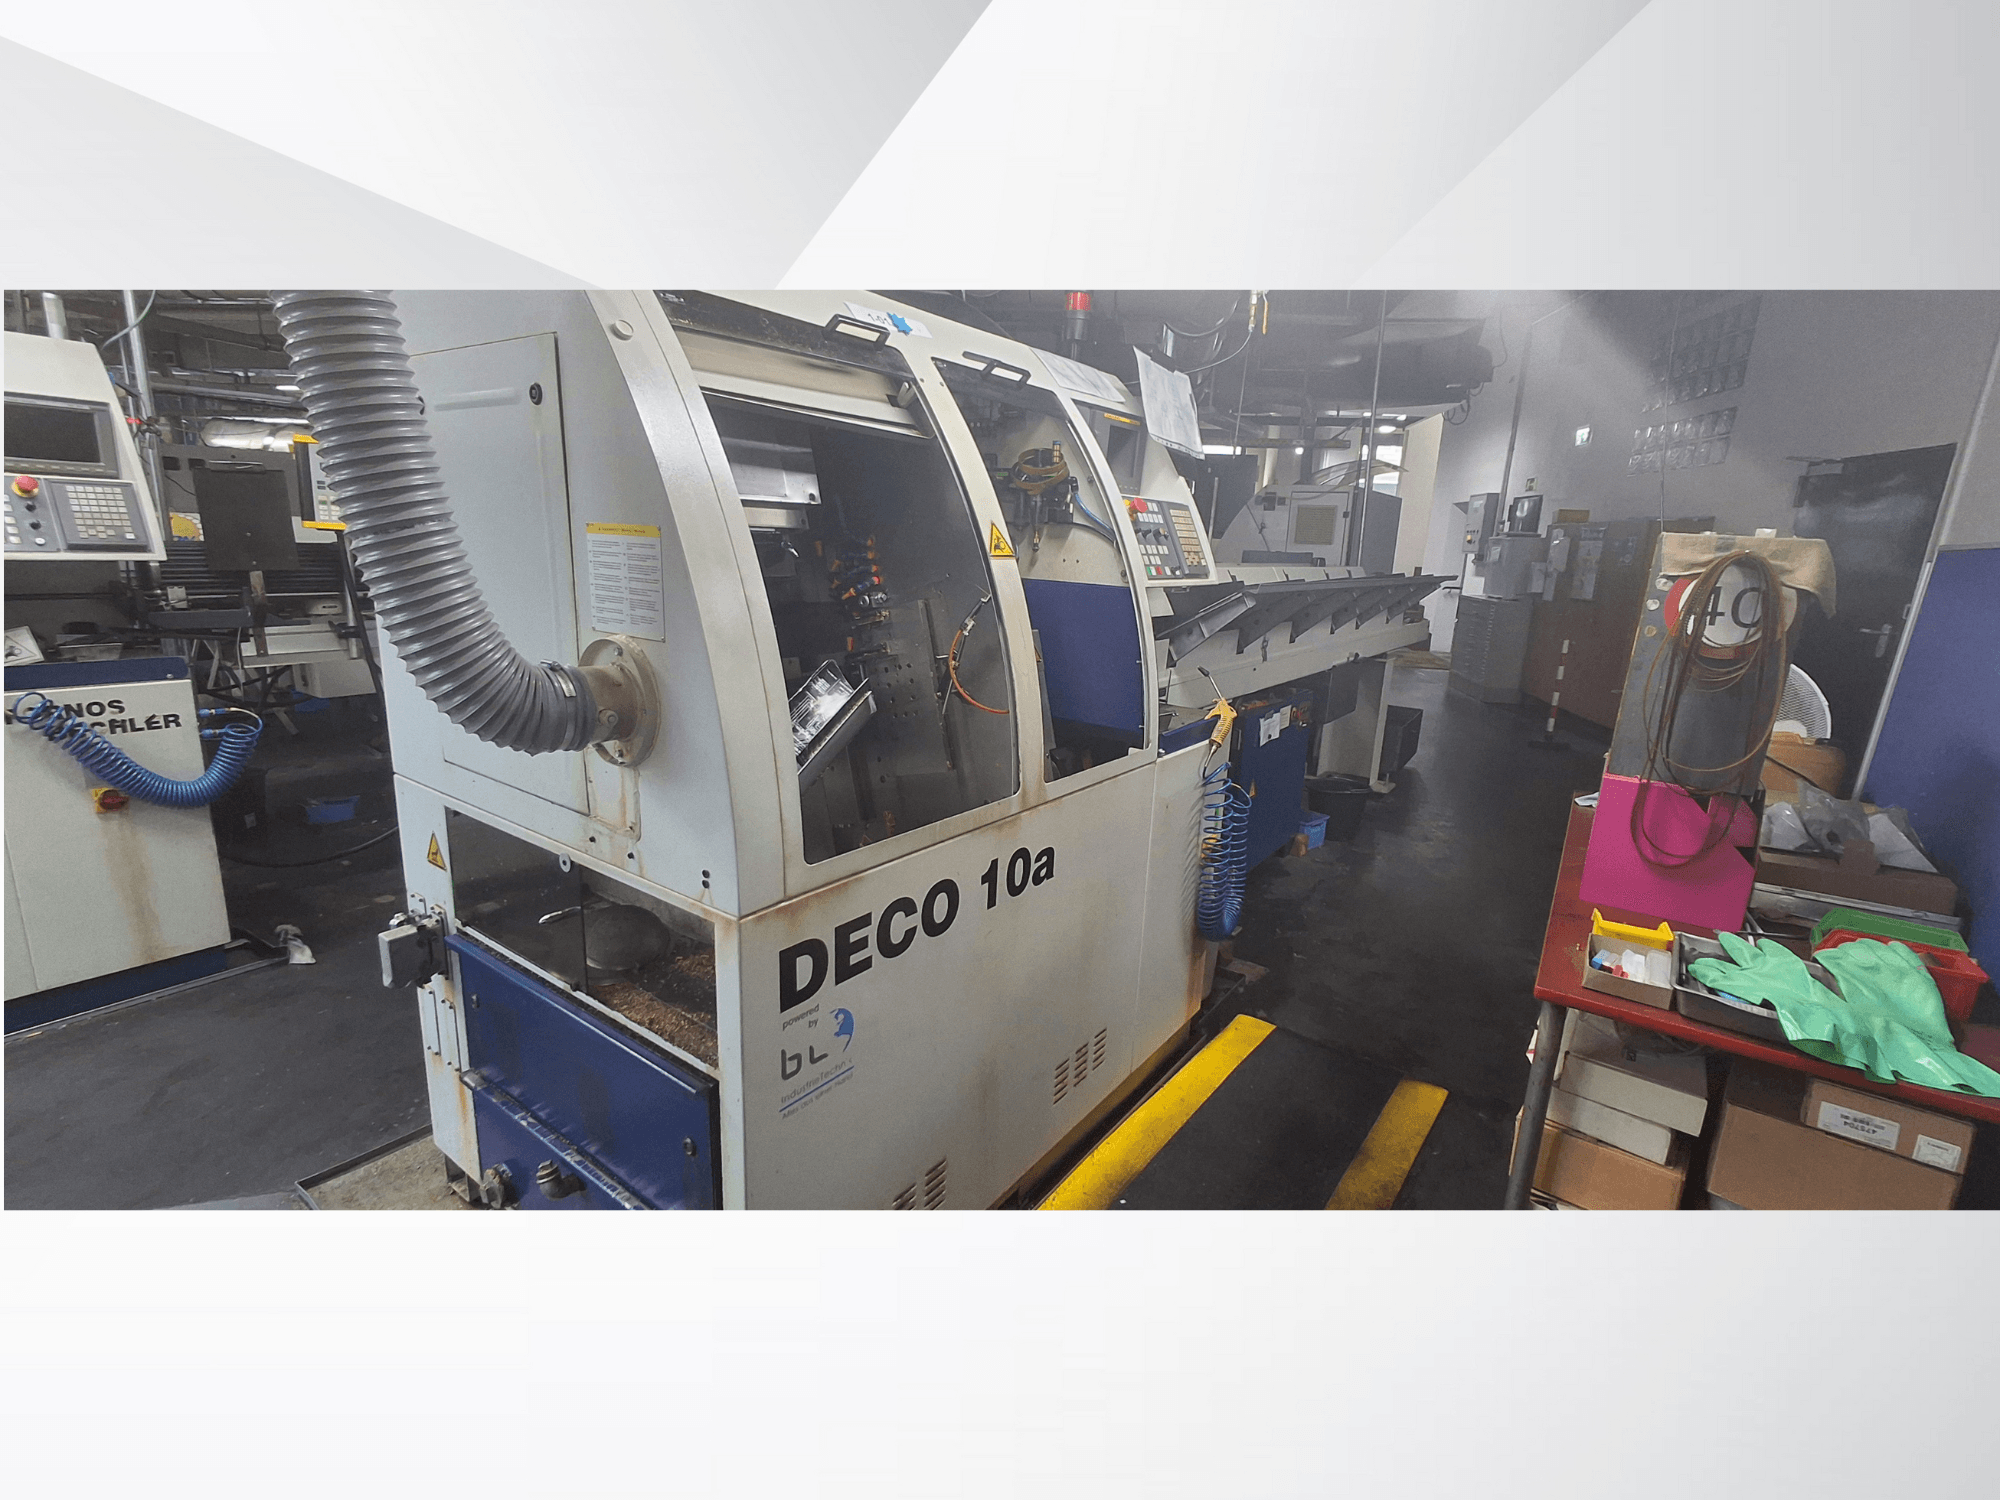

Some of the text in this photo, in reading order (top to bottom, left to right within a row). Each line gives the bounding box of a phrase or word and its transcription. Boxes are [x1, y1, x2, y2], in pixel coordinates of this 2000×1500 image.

[778, 846, 1055, 1014] DECO 10a
[782, 1003, 820, 1031] powered
[808, 1019, 819, 1029] by
